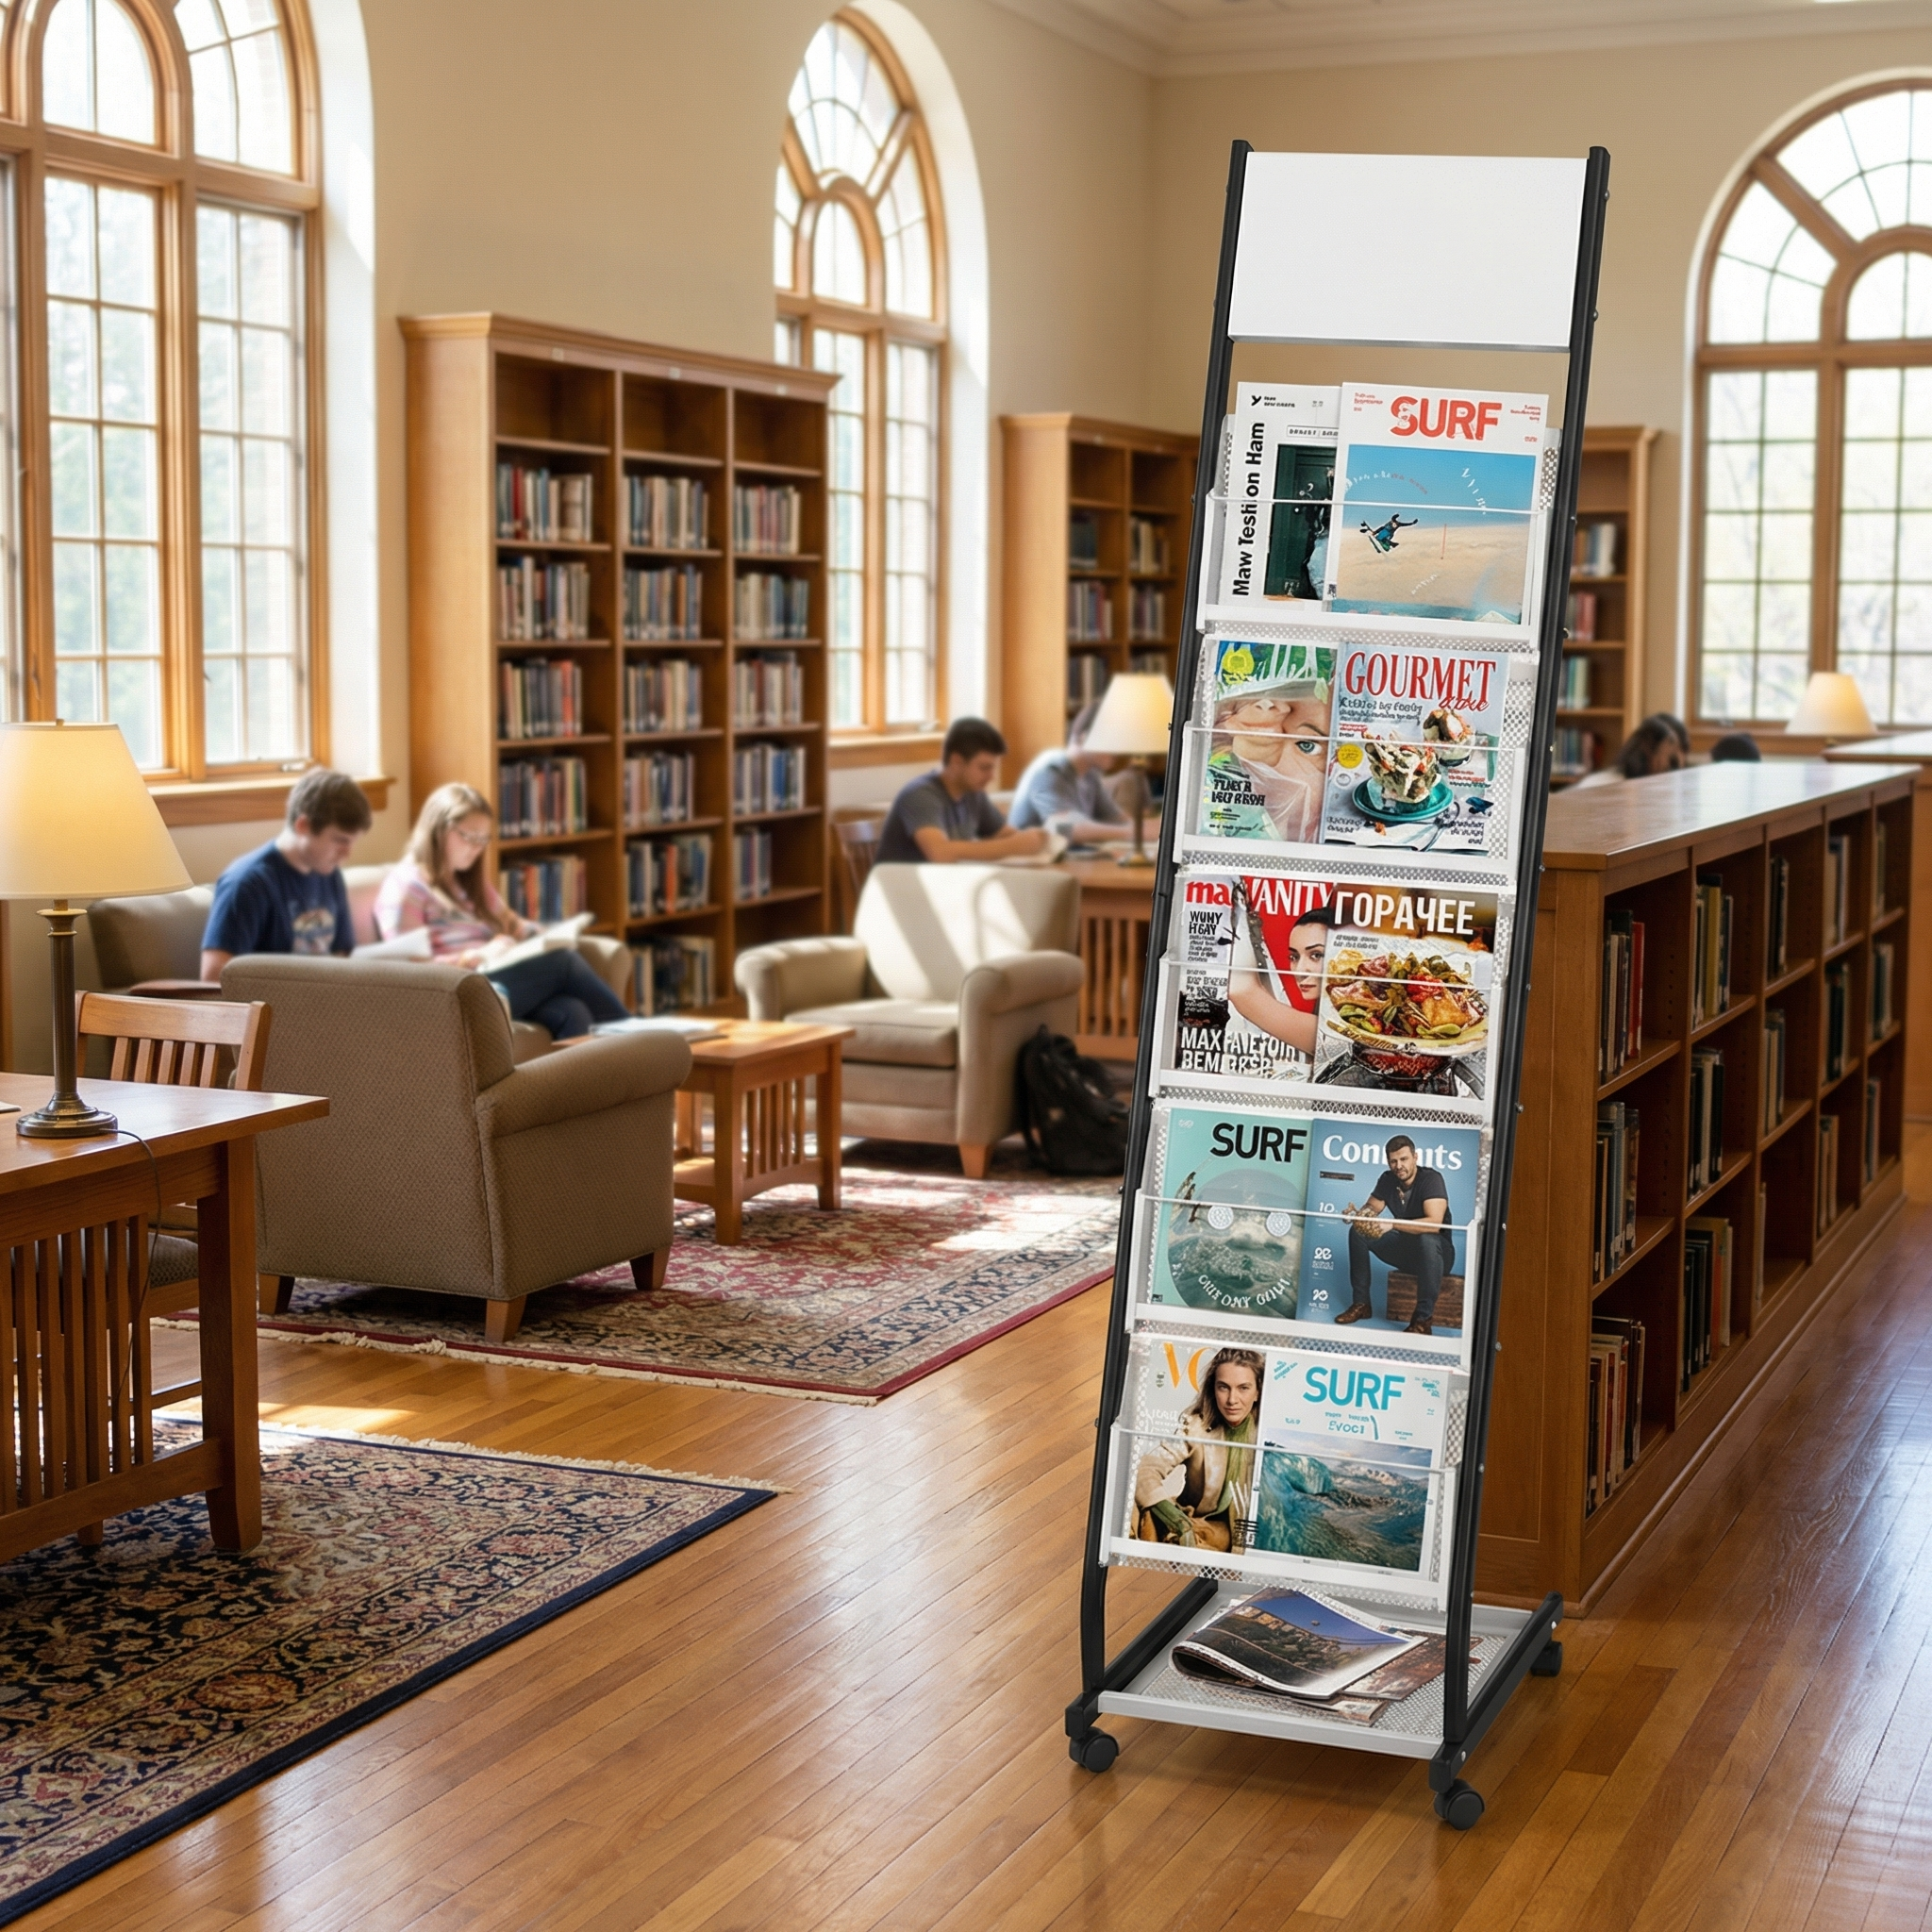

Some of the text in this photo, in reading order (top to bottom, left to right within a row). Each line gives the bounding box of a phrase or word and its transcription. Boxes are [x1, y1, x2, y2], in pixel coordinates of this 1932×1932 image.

[1390, 395, 1503, 441] SURF
[1232, 551, 1253, 596] Maw
[1245, 423, 1265, 465] Ham
[1345, 652, 1497, 702] GOURMET
[1334, 891, 1475, 935] ГОРАЧЕЕ
[1181, 1026, 1223, 1052] MAX
[1209, 1123, 1307, 1163] SURF
[1303, 1366, 1406, 1411] SURF
